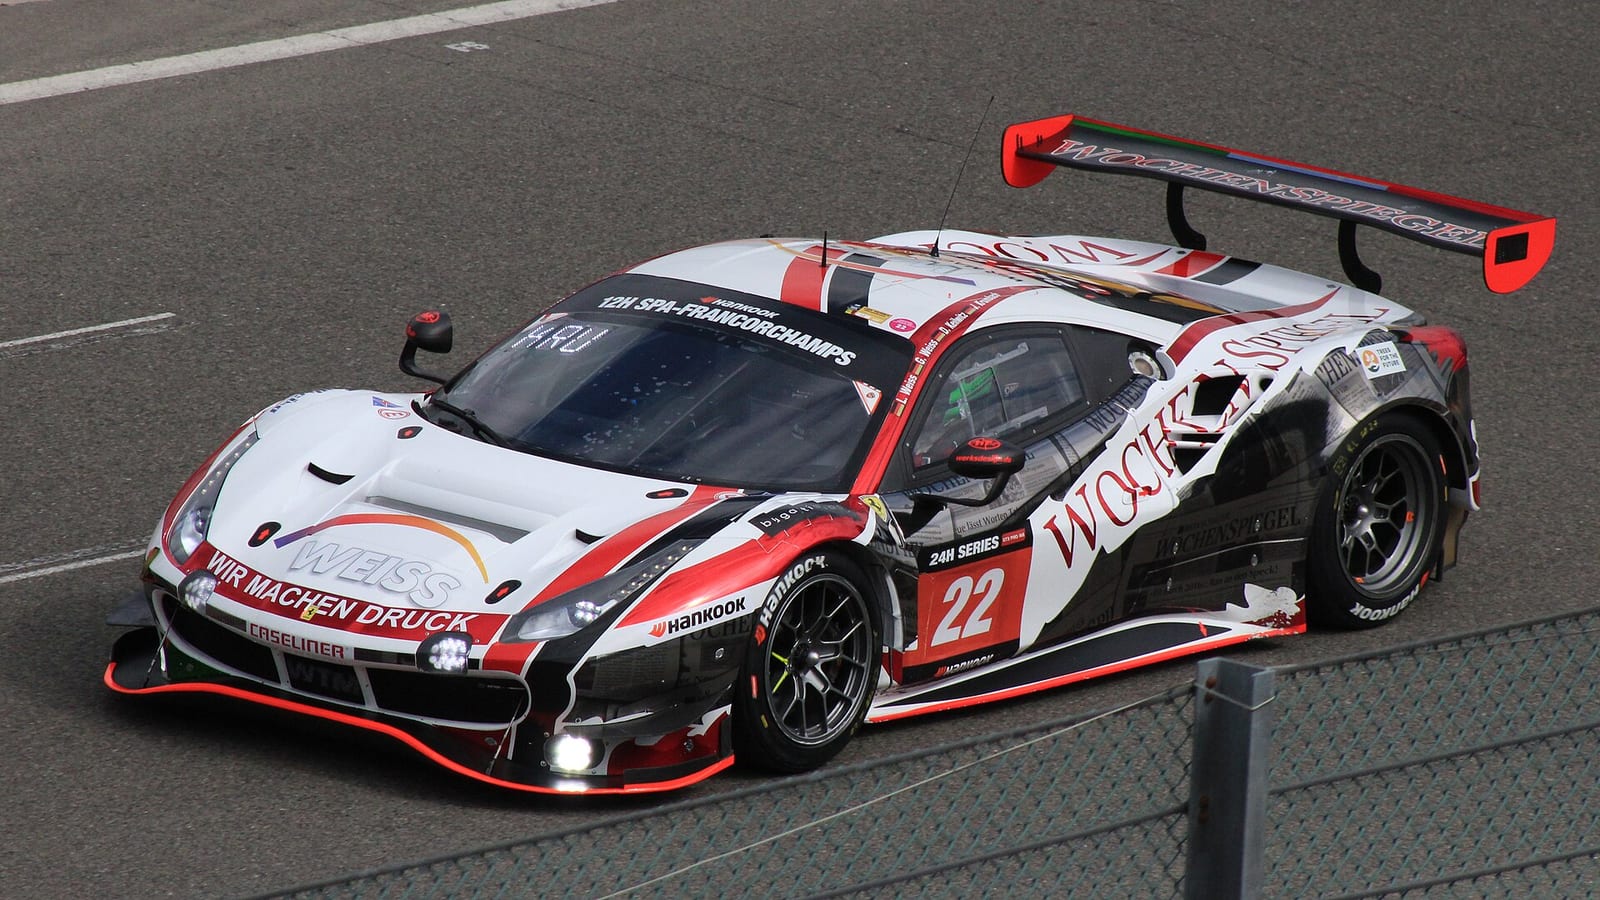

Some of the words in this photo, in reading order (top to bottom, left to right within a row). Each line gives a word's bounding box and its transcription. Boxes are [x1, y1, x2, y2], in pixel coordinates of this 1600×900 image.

[598, 296, 635, 309] 12H
[634, 298, 857, 366] SPA-FRANCORCHAMPS
[919, 339, 939, 358] Weiss
[899, 374, 918, 396] Weiss
[286, 540, 462, 609] WEISS
[928, 549, 955, 567] 24H
[957, 535, 1000, 560] SERIES
[205, 549, 251, 589] WIR
[245, 575, 354, 621] MACHEN
[355, 605, 480, 632] DRUCK
[930, 567, 1005, 648] 22
[250, 623, 345, 660] CASELINER
